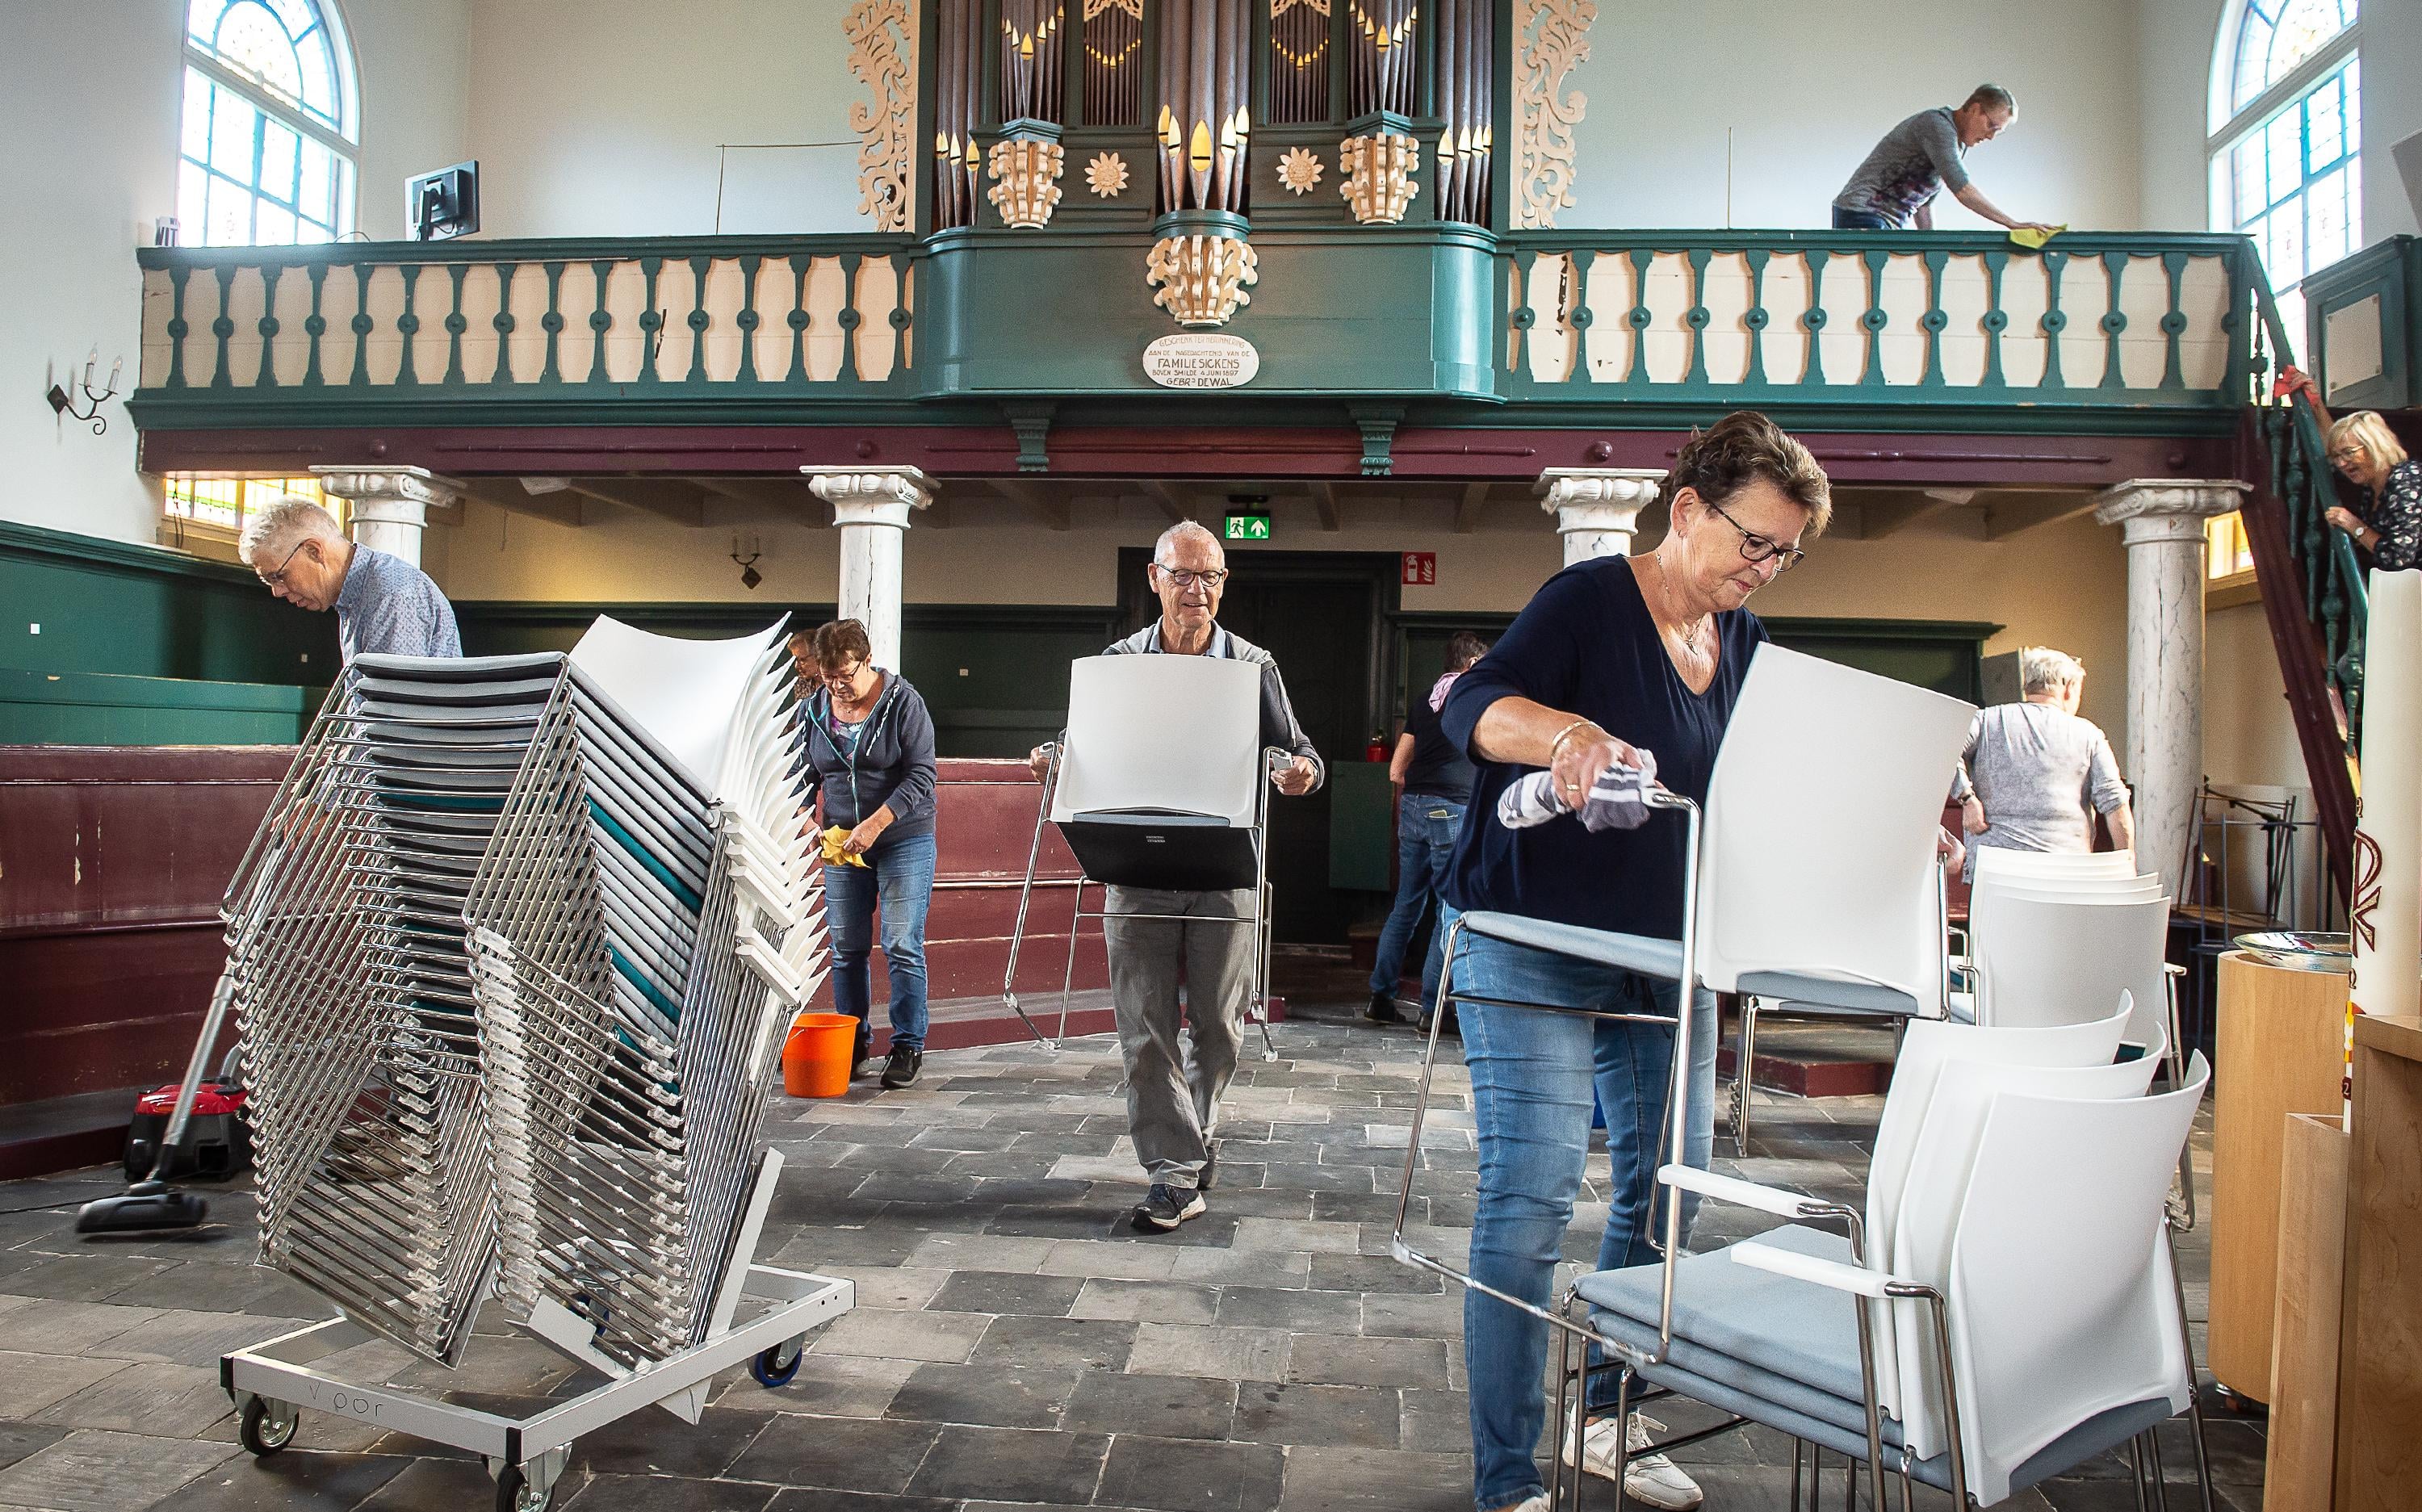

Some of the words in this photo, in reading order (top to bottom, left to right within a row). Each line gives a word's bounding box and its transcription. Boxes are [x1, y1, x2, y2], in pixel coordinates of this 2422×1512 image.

[1159, 358, 1196, 368] FAMILIE
[1199, 358, 1239, 369] SICKENS
[1197, 378, 1209, 387] DE
[1209, 378, 1233, 387] WAL
